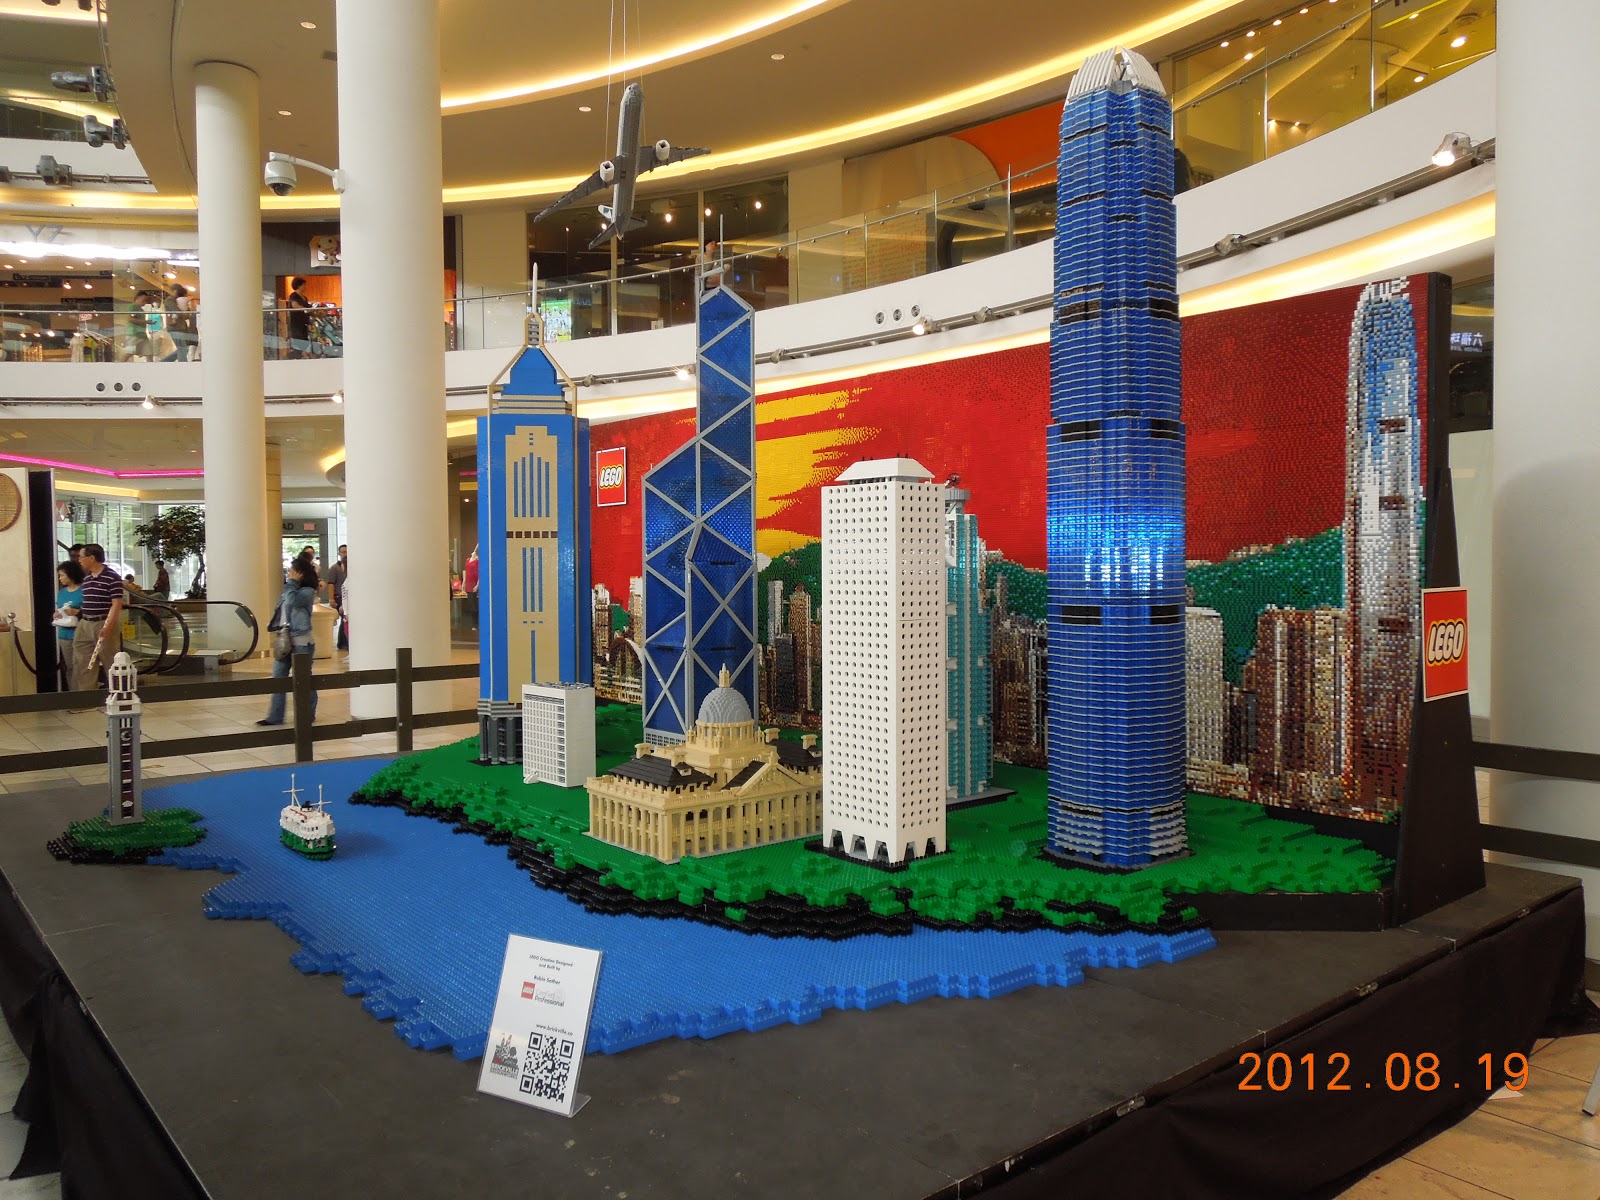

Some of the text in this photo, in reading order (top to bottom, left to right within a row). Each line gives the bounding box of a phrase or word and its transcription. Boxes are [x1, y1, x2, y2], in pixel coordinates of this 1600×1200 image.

[599, 465, 624, 488] LEGO
[1427, 620, 1466, 665] LEGO
[556, 959, 574, 968] Designed
[534, 995, 565, 1007] Professional
